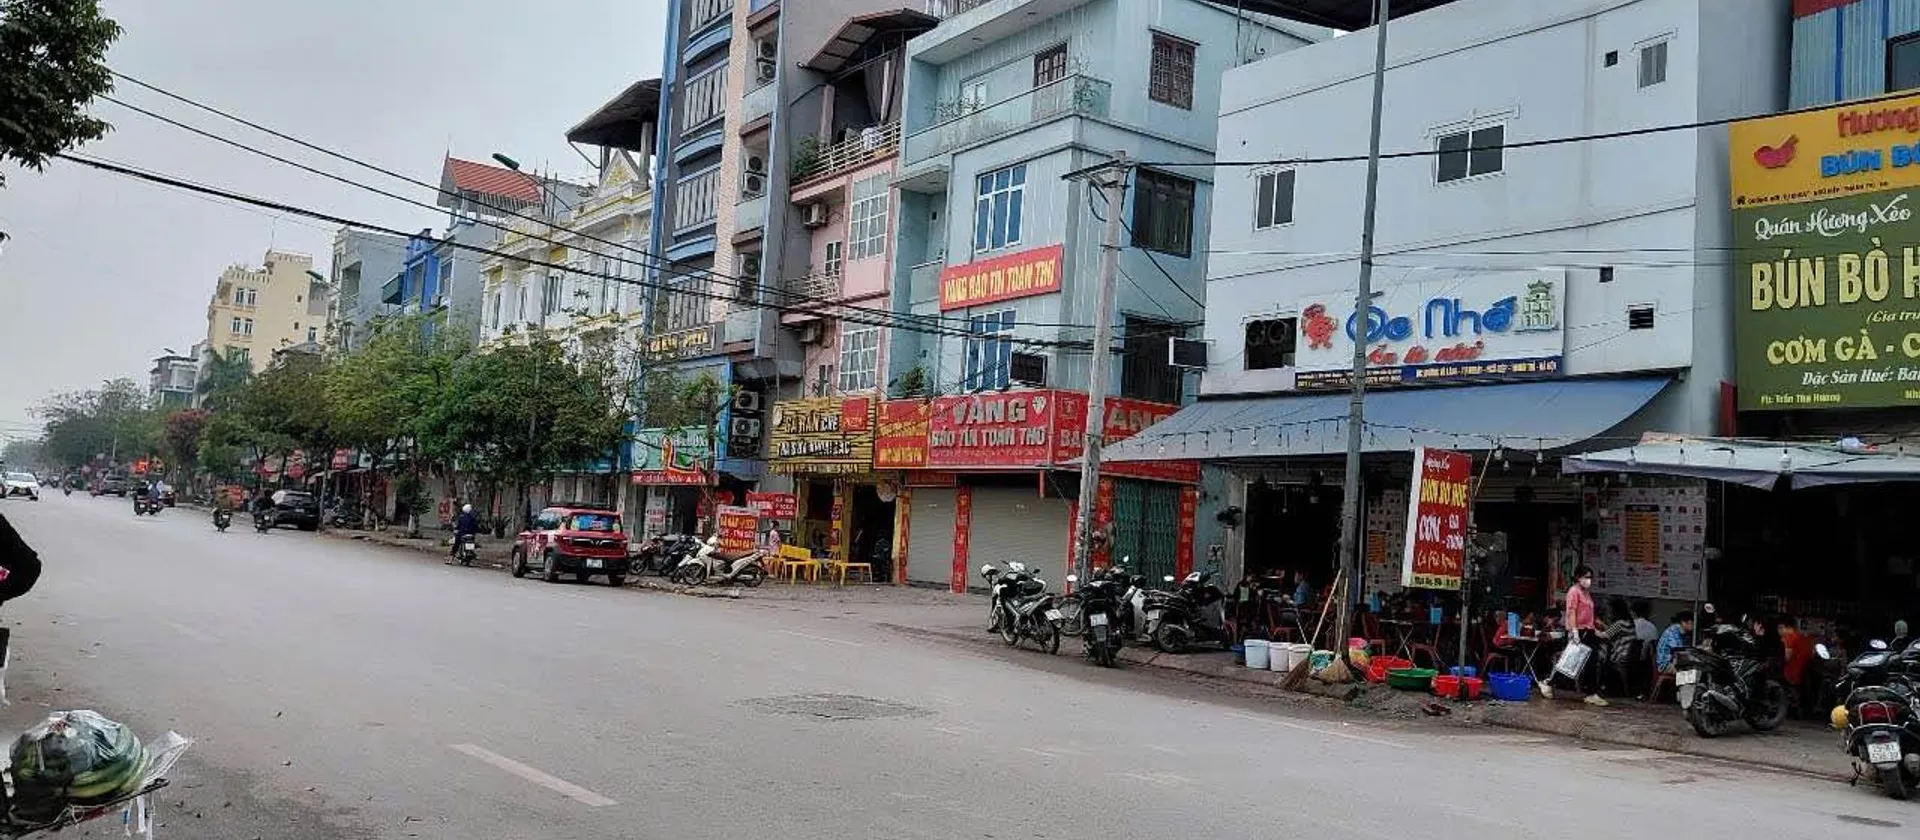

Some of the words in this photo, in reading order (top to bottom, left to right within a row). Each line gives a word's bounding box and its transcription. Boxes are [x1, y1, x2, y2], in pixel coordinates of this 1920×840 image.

[1820, 149, 1883, 178] BÚN
[1755, 217, 1802, 240] Quán
[1805, 208, 1868, 237] Hương
[1869, 193, 1911, 224] Xèo
[1751, 249, 1826, 311] BÚN
[1838, 237, 1891, 304] BÒ
[1767, 334, 1827, 365] CƠM
[1834, 328, 1878, 362] GÀ
[1802, 371, 1830, 389] Đặc
[1830, 369, 1857, 385] Sản
[1860, 365, 1894, 384] Huế:
[953, 395, 1027, 425] VÀNG
